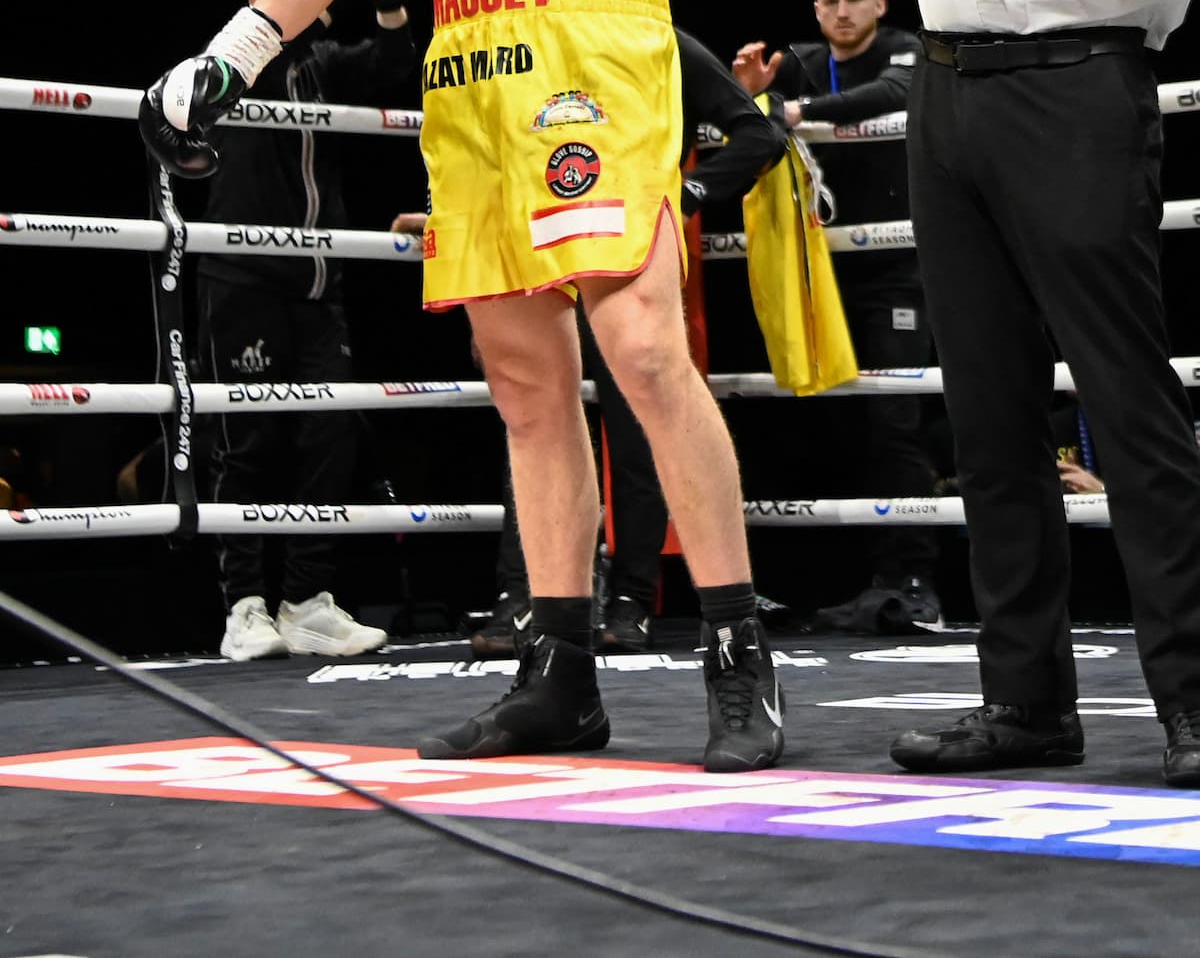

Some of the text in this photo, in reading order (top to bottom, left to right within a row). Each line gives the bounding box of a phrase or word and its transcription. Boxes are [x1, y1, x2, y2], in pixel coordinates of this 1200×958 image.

[227, 103, 332, 126] BOXXER
[226, 228, 332, 250] BOXXER
[228, 383, 335, 403] BOXXER
[242, 503, 350, 522] BOXXER
[431, 512, 472, 522] SEASON
[895, 503, 937, 514] SEASON
